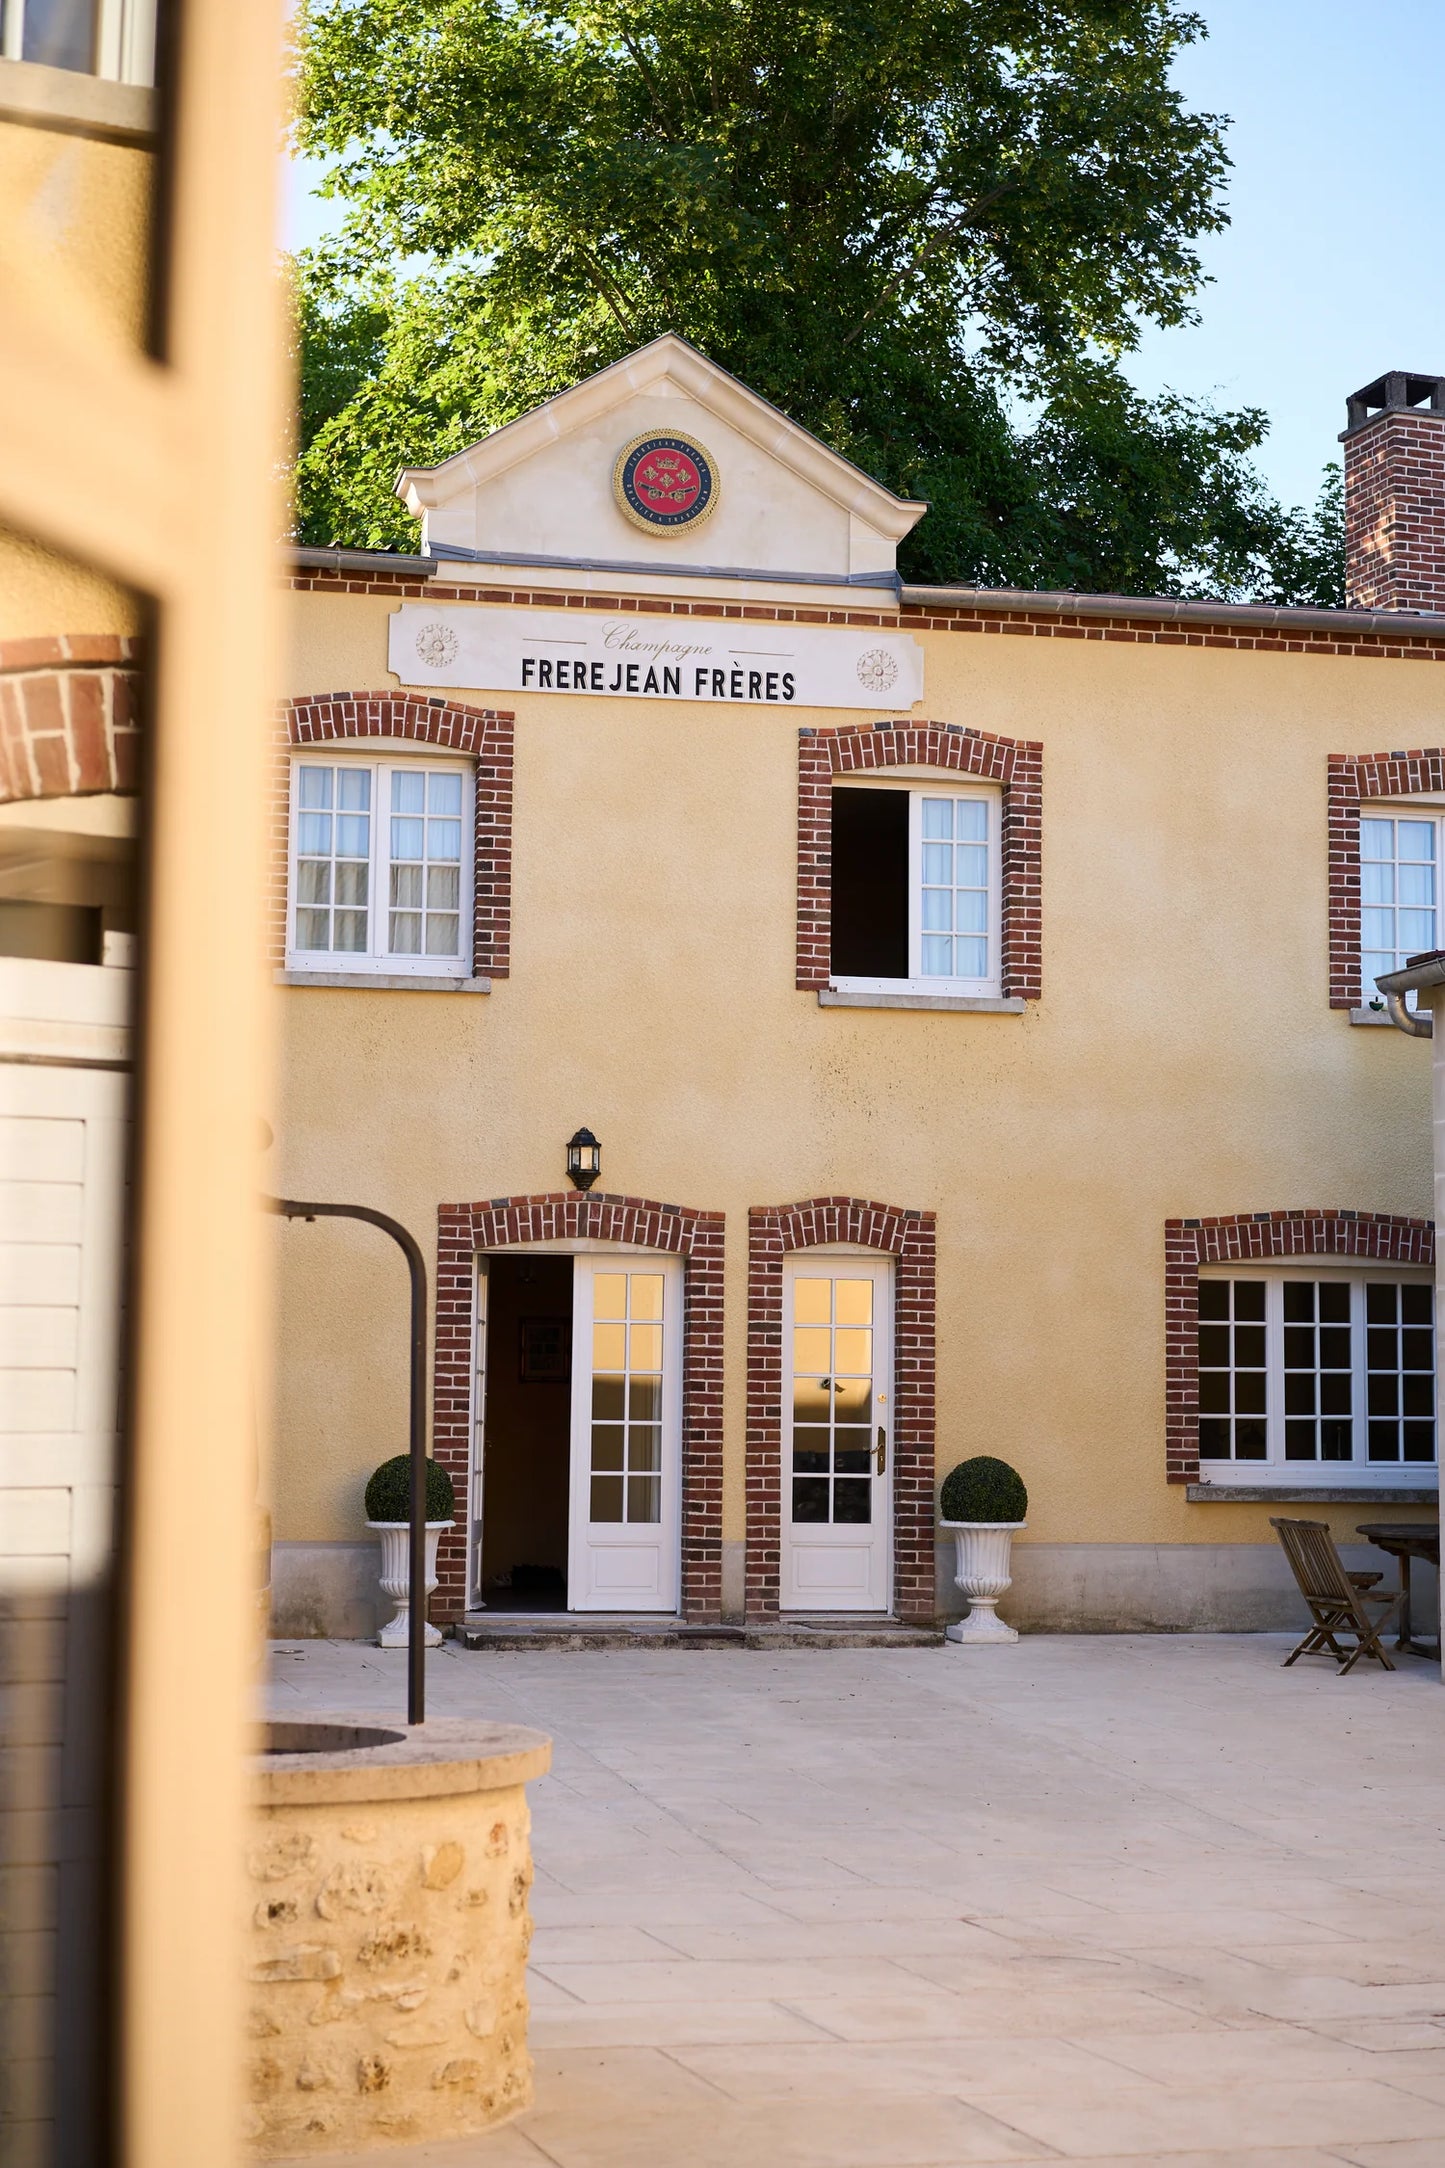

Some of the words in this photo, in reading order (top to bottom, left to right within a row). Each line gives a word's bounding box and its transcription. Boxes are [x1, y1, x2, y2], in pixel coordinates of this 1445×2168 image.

[601, 621, 713, 661] Champagne
[522, 658, 680, 695] FREREJEAN
[695, 661, 796, 701] FRÈRES
